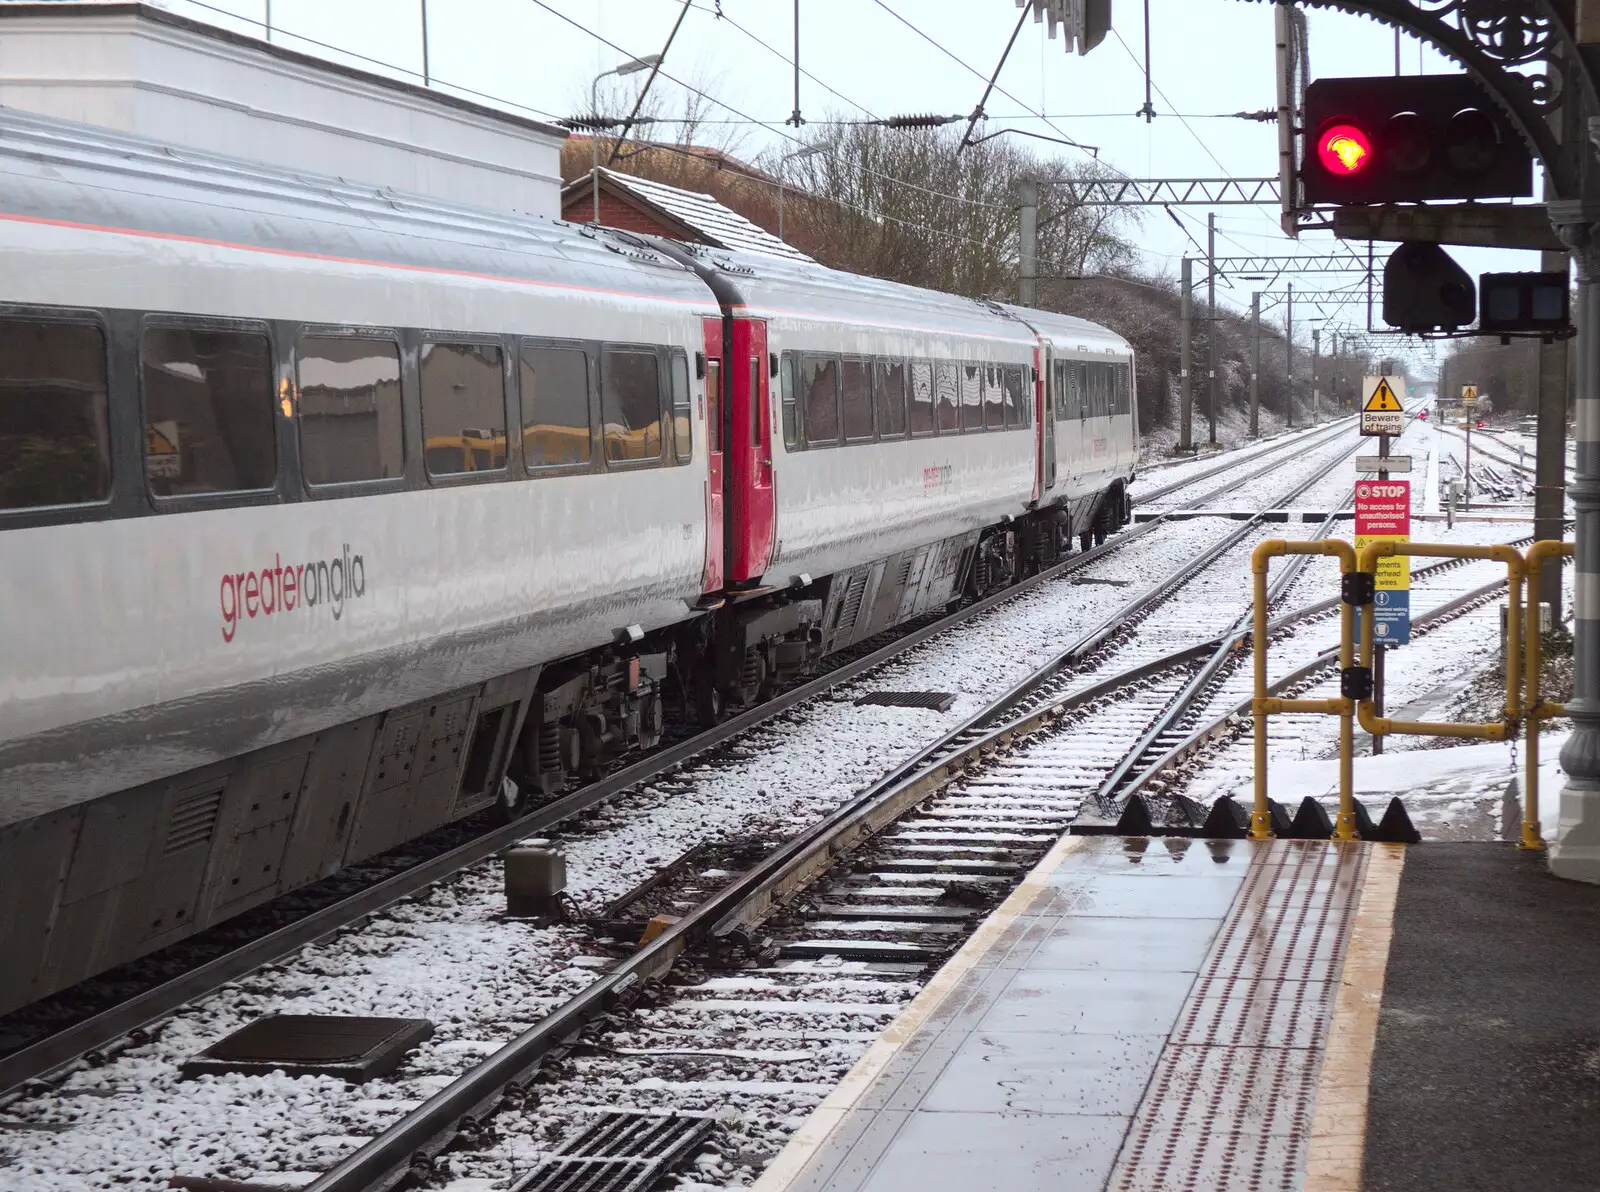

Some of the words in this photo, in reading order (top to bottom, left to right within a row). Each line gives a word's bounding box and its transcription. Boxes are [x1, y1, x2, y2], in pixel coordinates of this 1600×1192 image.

[1365, 414, 1400, 422] Beware
[1365, 423, 1375, 432] of
[1376, 423, 1402, 431] trains
[1372, 485, 1406, 497] STOP
[220, 543, 365, 643] greateranglia
